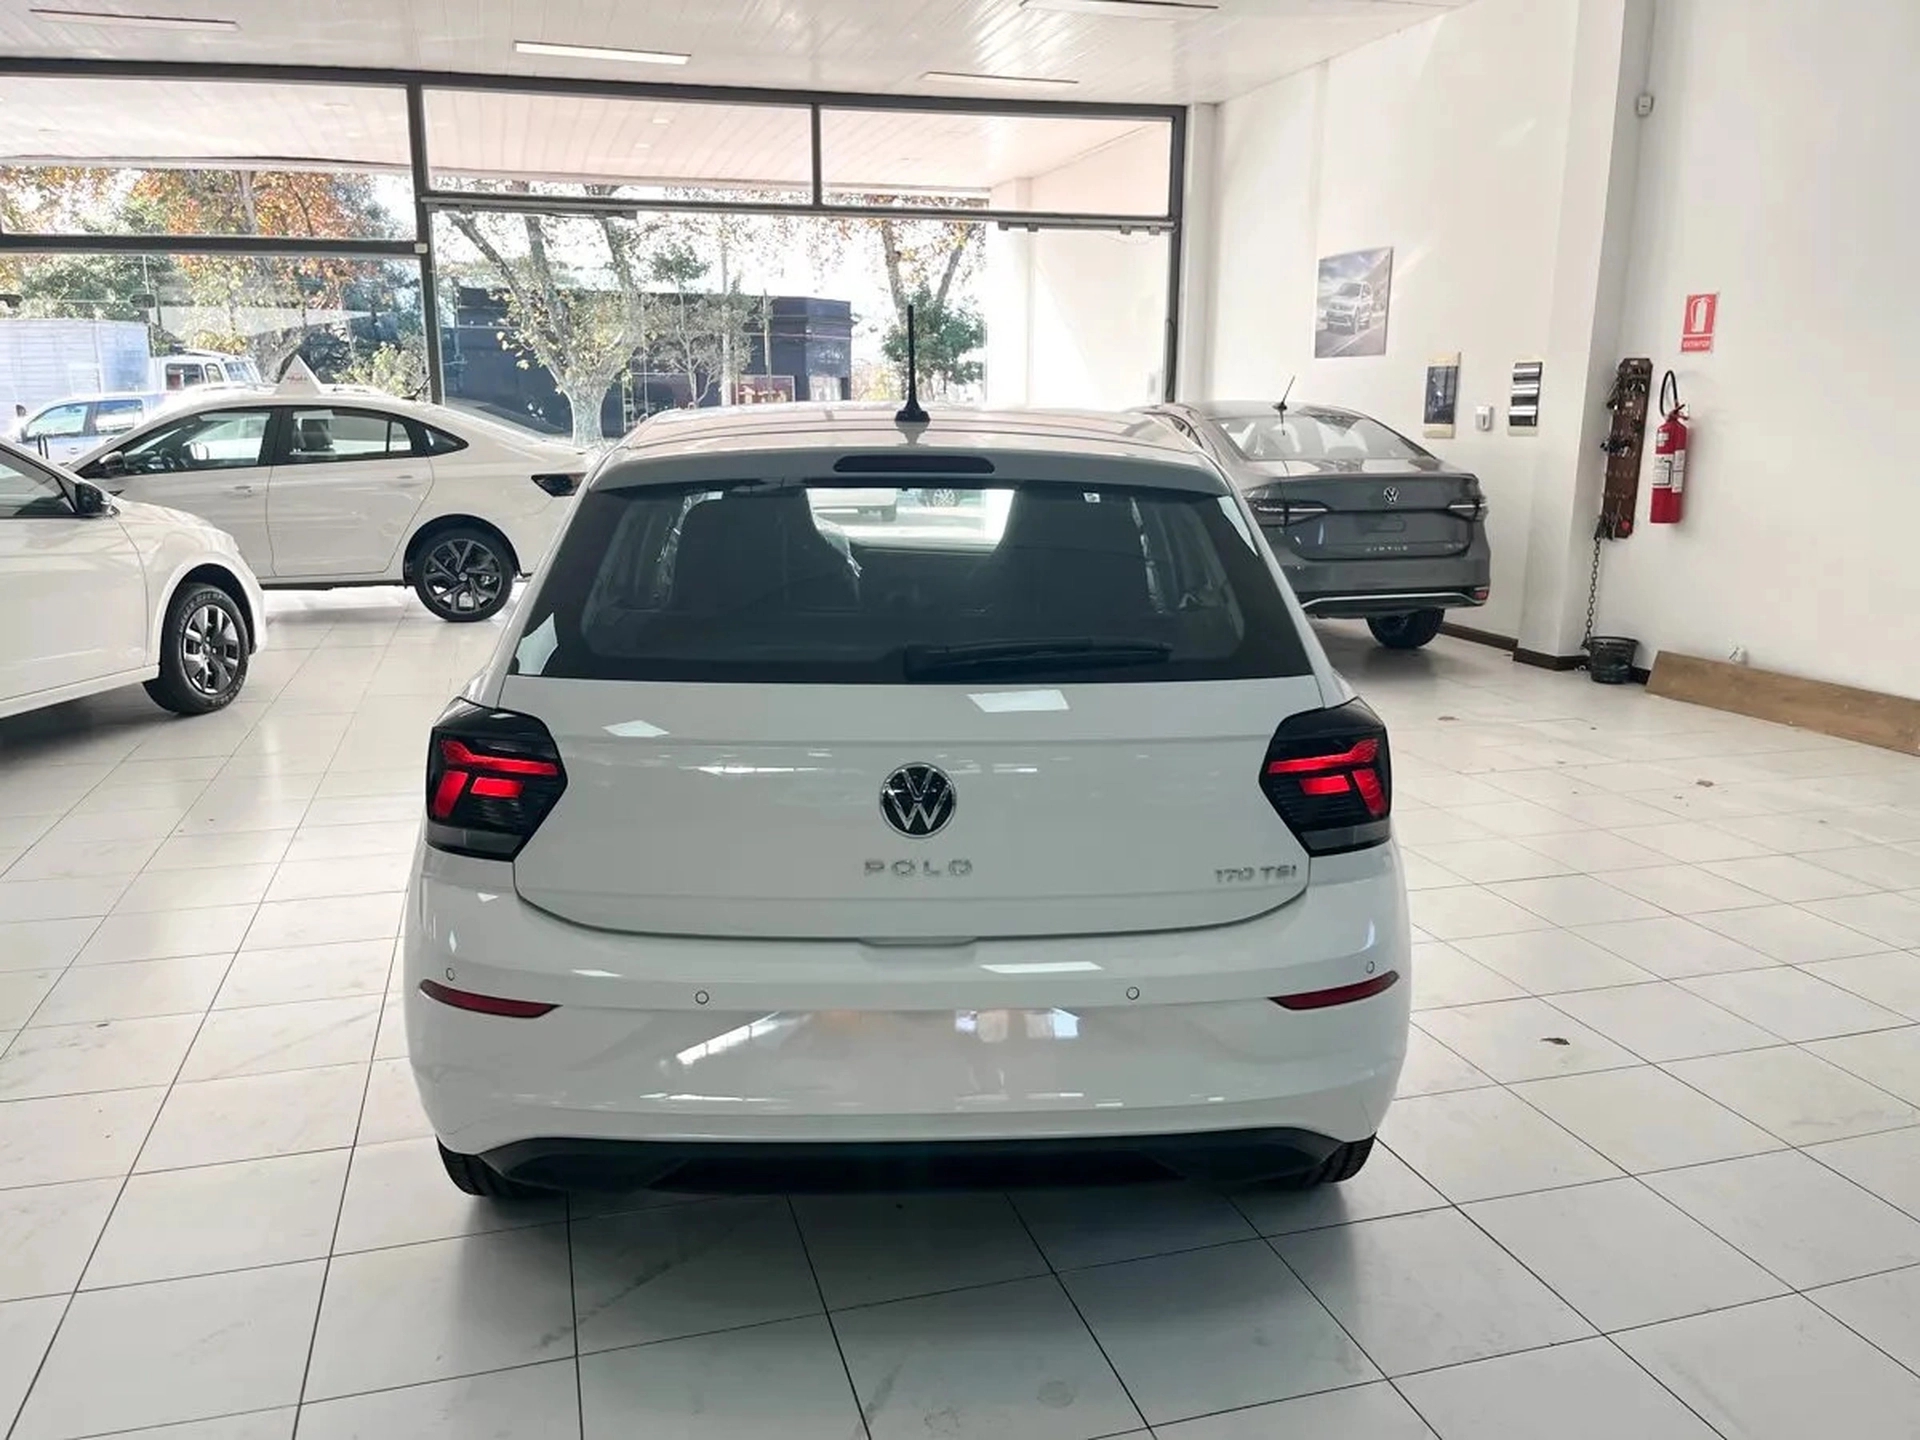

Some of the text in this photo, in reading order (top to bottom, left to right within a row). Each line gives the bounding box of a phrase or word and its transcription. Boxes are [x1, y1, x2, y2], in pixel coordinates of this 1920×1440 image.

[1383, 485, 1400, 504] VW
[881, 764, 956, 836] VW
[863, 858, 973, 877] POLO
[1215, 864, 1297, 882] 170 TSI
